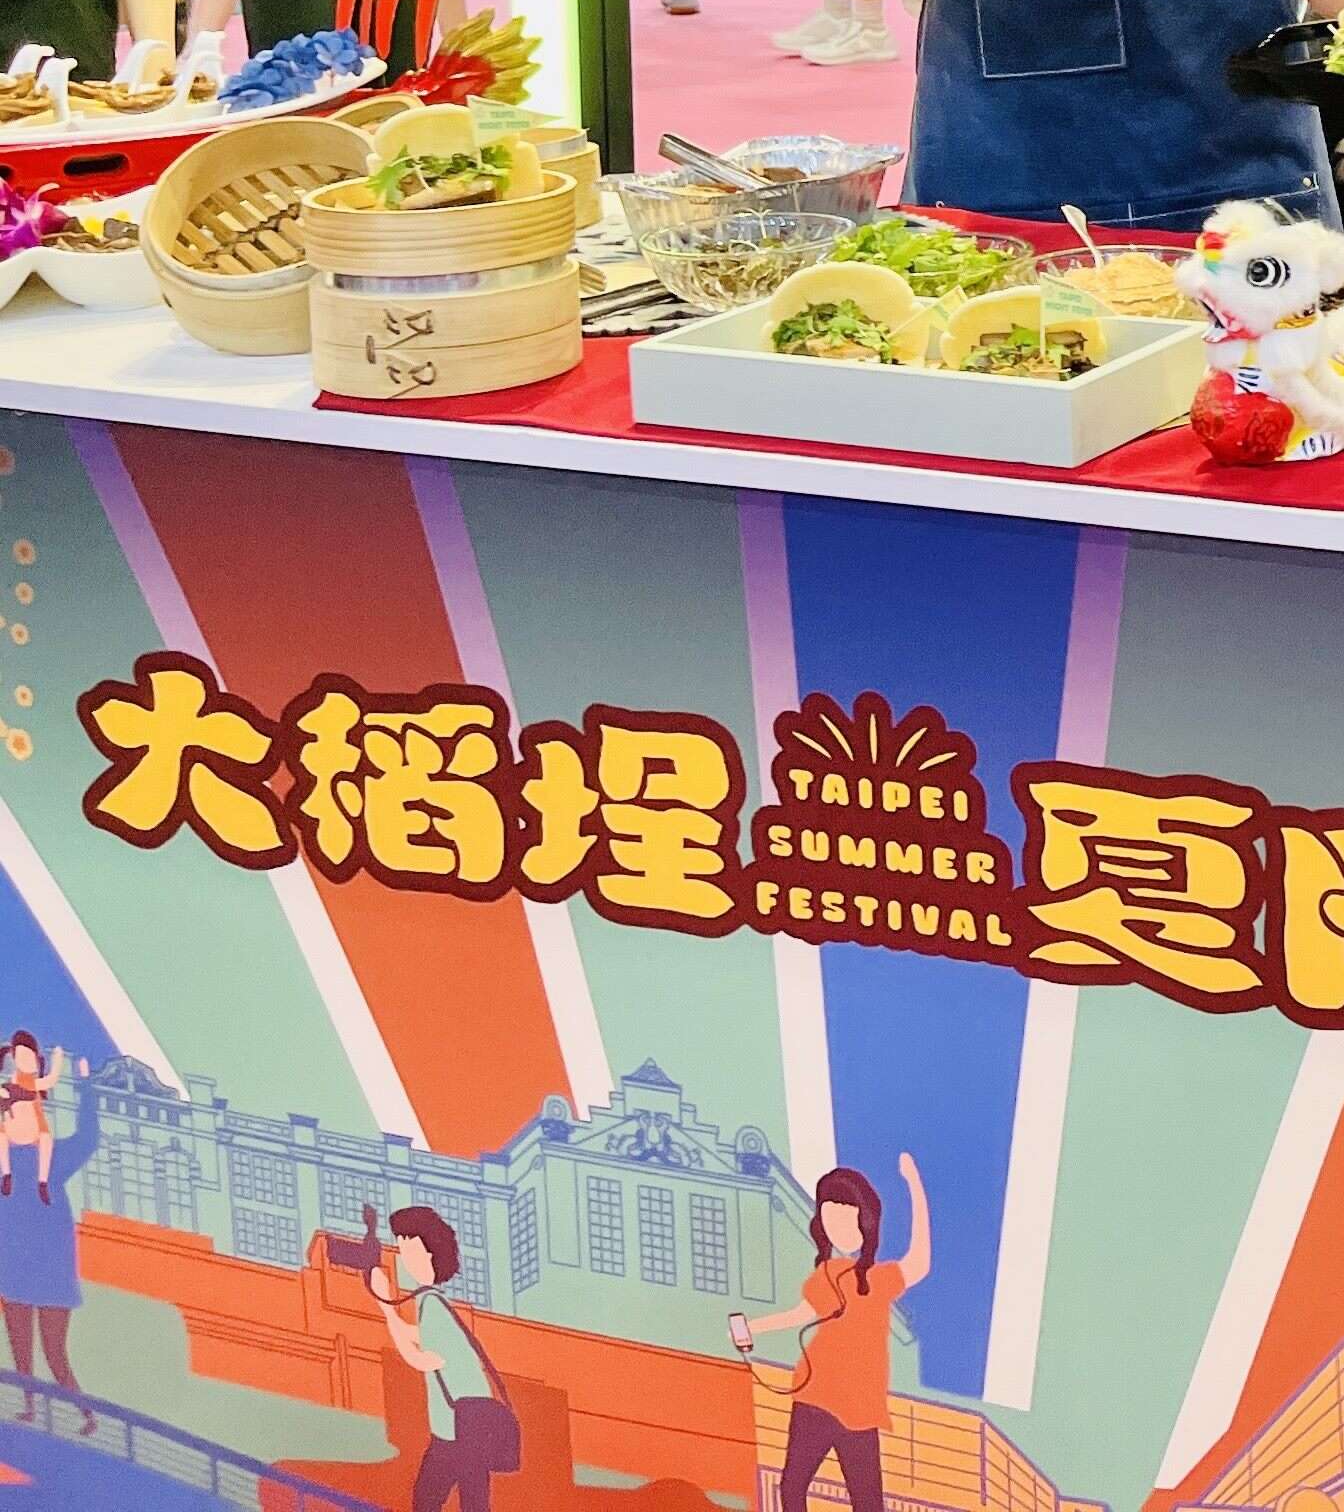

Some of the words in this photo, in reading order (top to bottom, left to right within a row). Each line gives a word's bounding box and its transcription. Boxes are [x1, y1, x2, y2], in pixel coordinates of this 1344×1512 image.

[92, 670, 736, 918] 大稻埕
[789, 769, 968, 821] TAIPEI
[768, 825, 995, 884] SUMMER
[756, 881, 1012, 946] FESTIVAL
